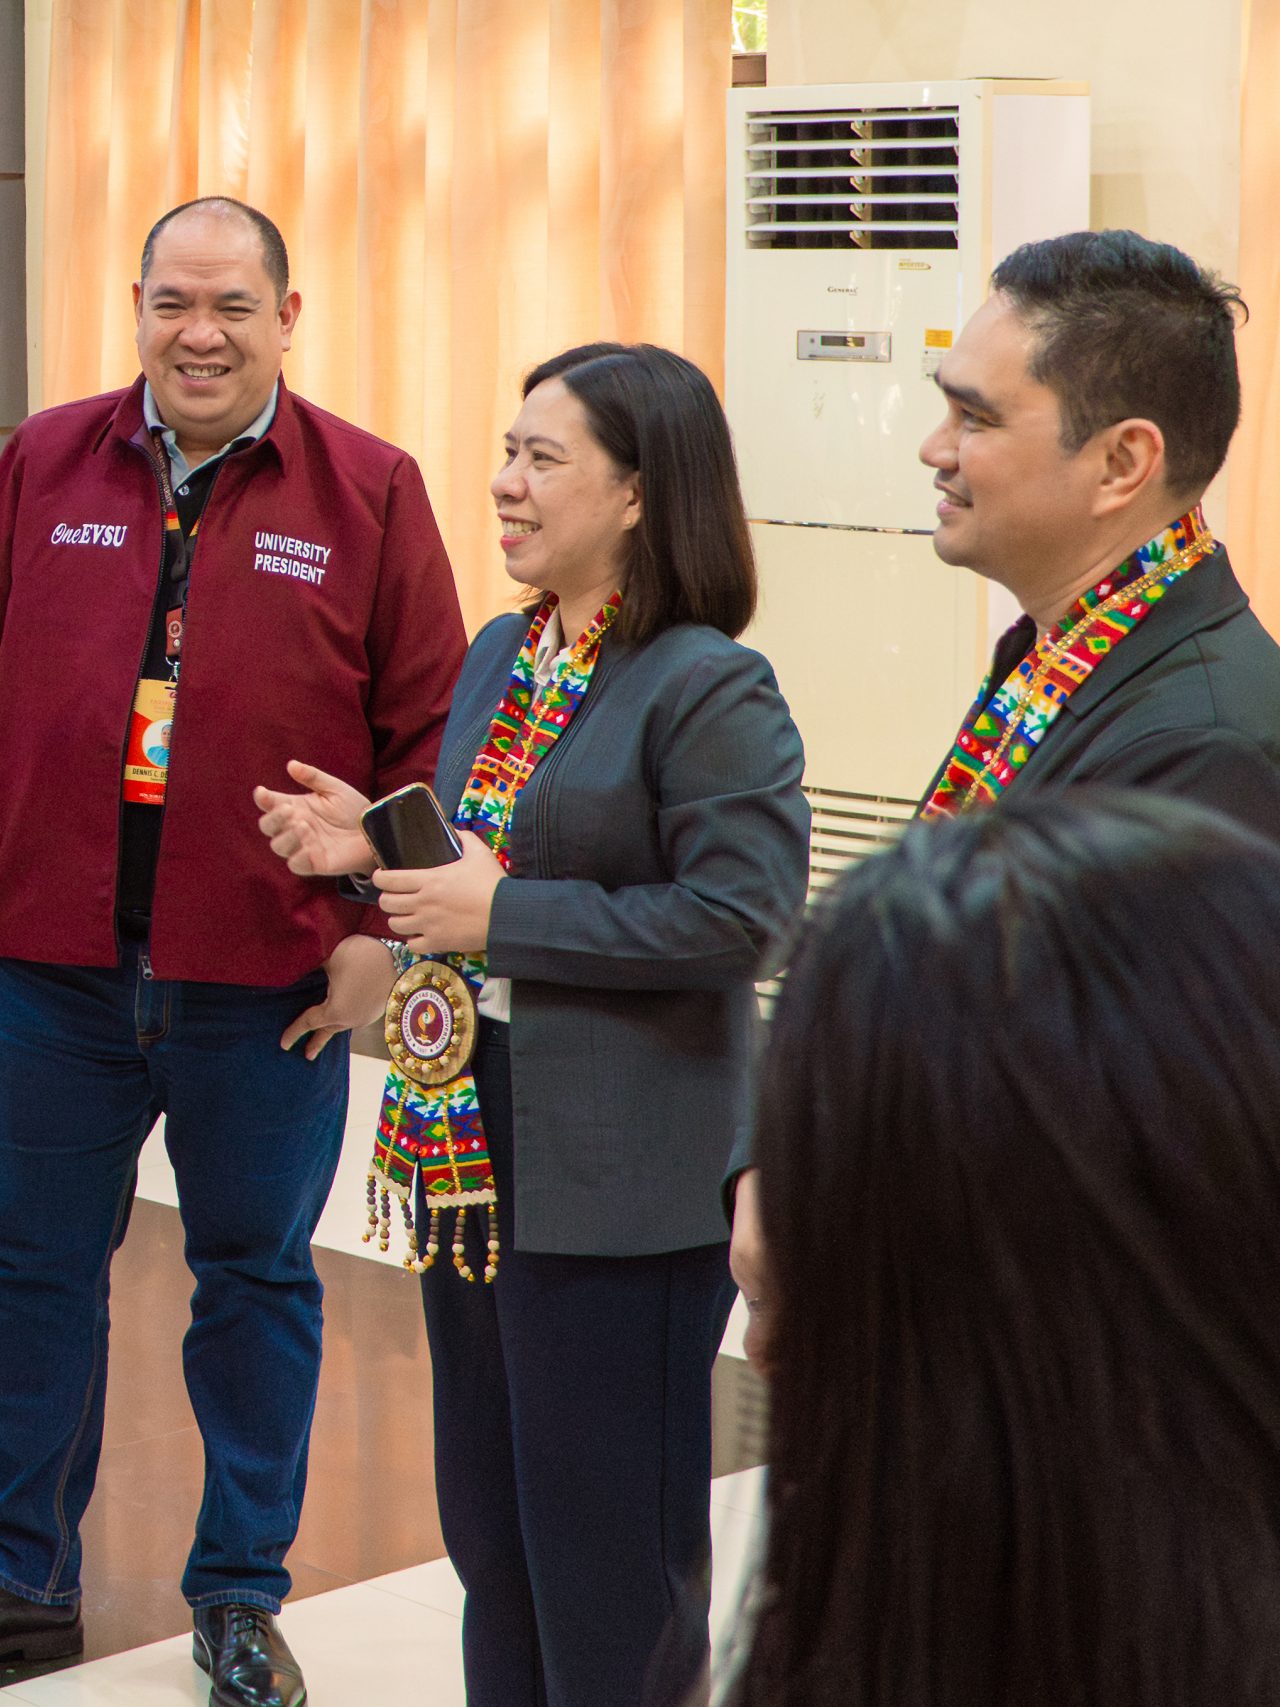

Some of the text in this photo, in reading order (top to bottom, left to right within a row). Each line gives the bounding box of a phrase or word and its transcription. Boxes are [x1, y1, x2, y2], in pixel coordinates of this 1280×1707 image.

[51, 523, 128, 547] OneEVSU
[254, 531, 332, 565] UNIVERSITY
[254, 553, 326, 585] PRESIDENT
[132, 767, 153, 777] DENNIS
